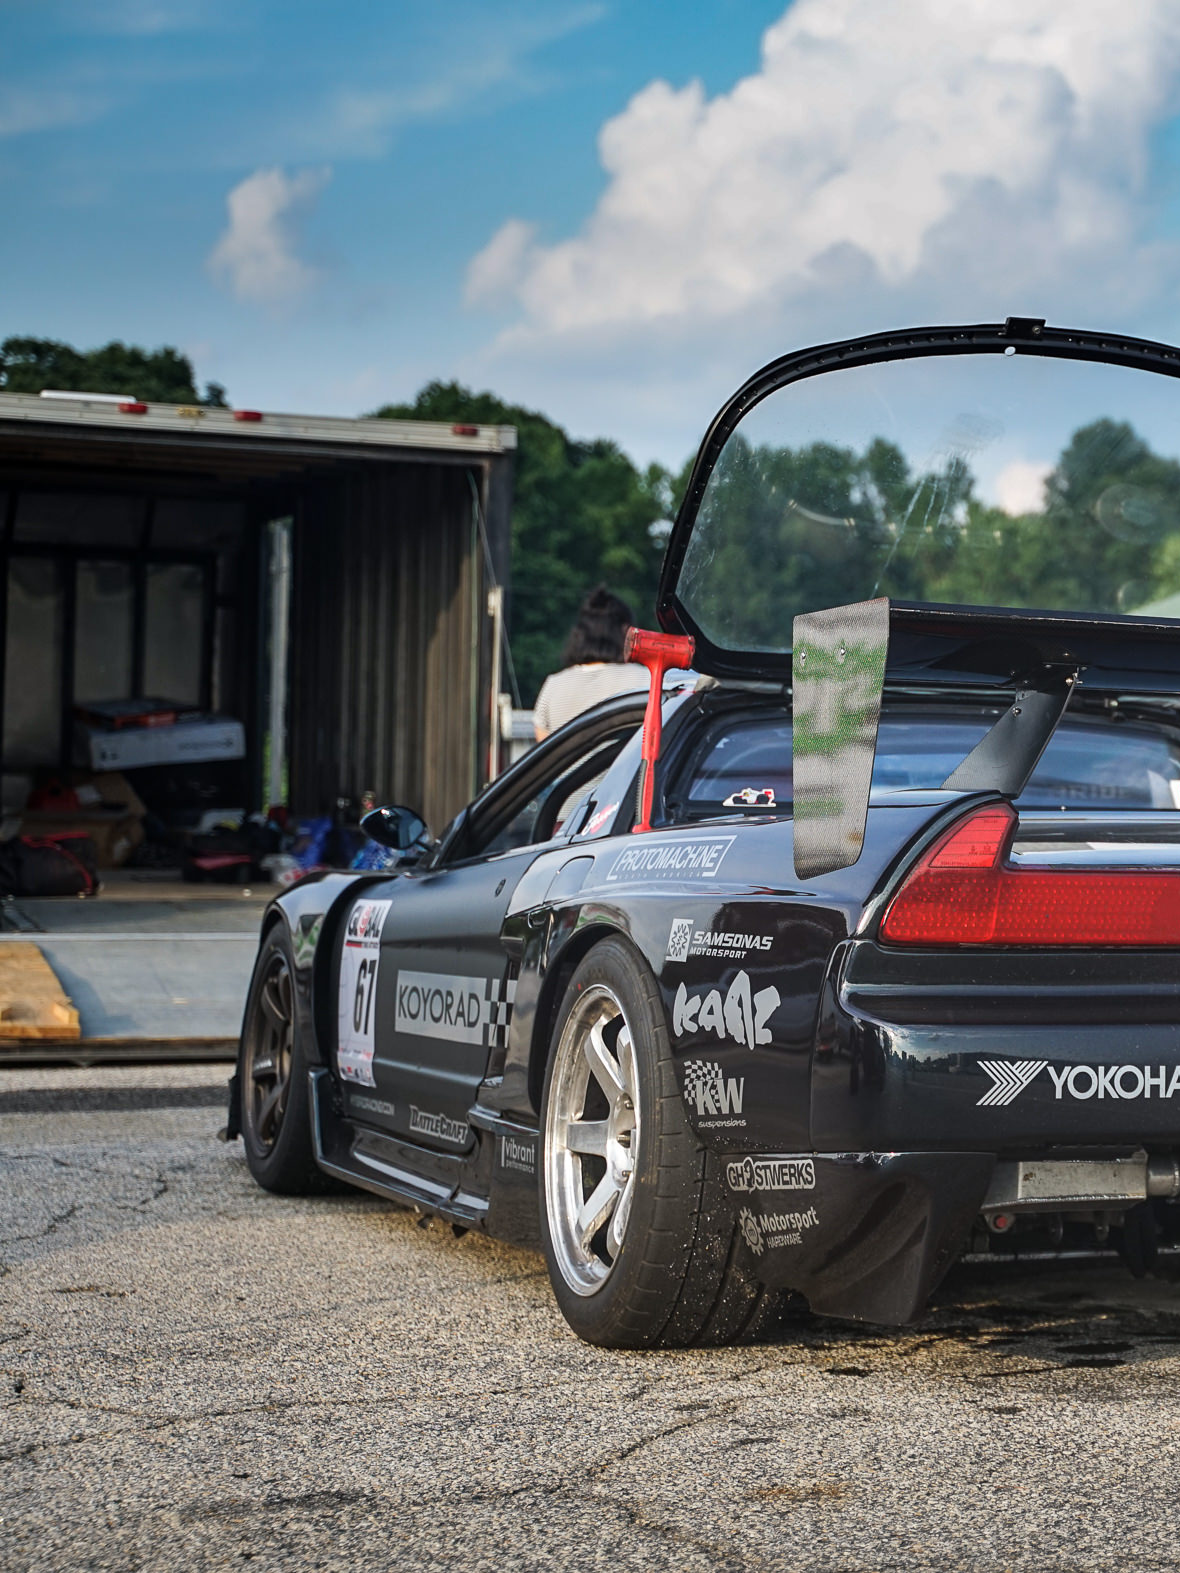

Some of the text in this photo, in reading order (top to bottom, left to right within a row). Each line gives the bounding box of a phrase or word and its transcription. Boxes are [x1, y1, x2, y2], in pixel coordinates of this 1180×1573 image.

[615, 844, 724, 873] PROTOMACHINE
[688, 946, 748, 959] MOTORSPORT
[692, 931, 774, 950] SAMSONAS
[353, 958, 377, 1035] 67
[398, 984, 481, 1028] KOYORAD
[695, 1077, 744, 1115] KW
[698, 1117, 747, 1129] suspensions
[505, 1138, 535, 1164] vibrant
[759, 1206, 820, 1233] Motorsport
[766, 1232, 803, 1249] HARDWARE
